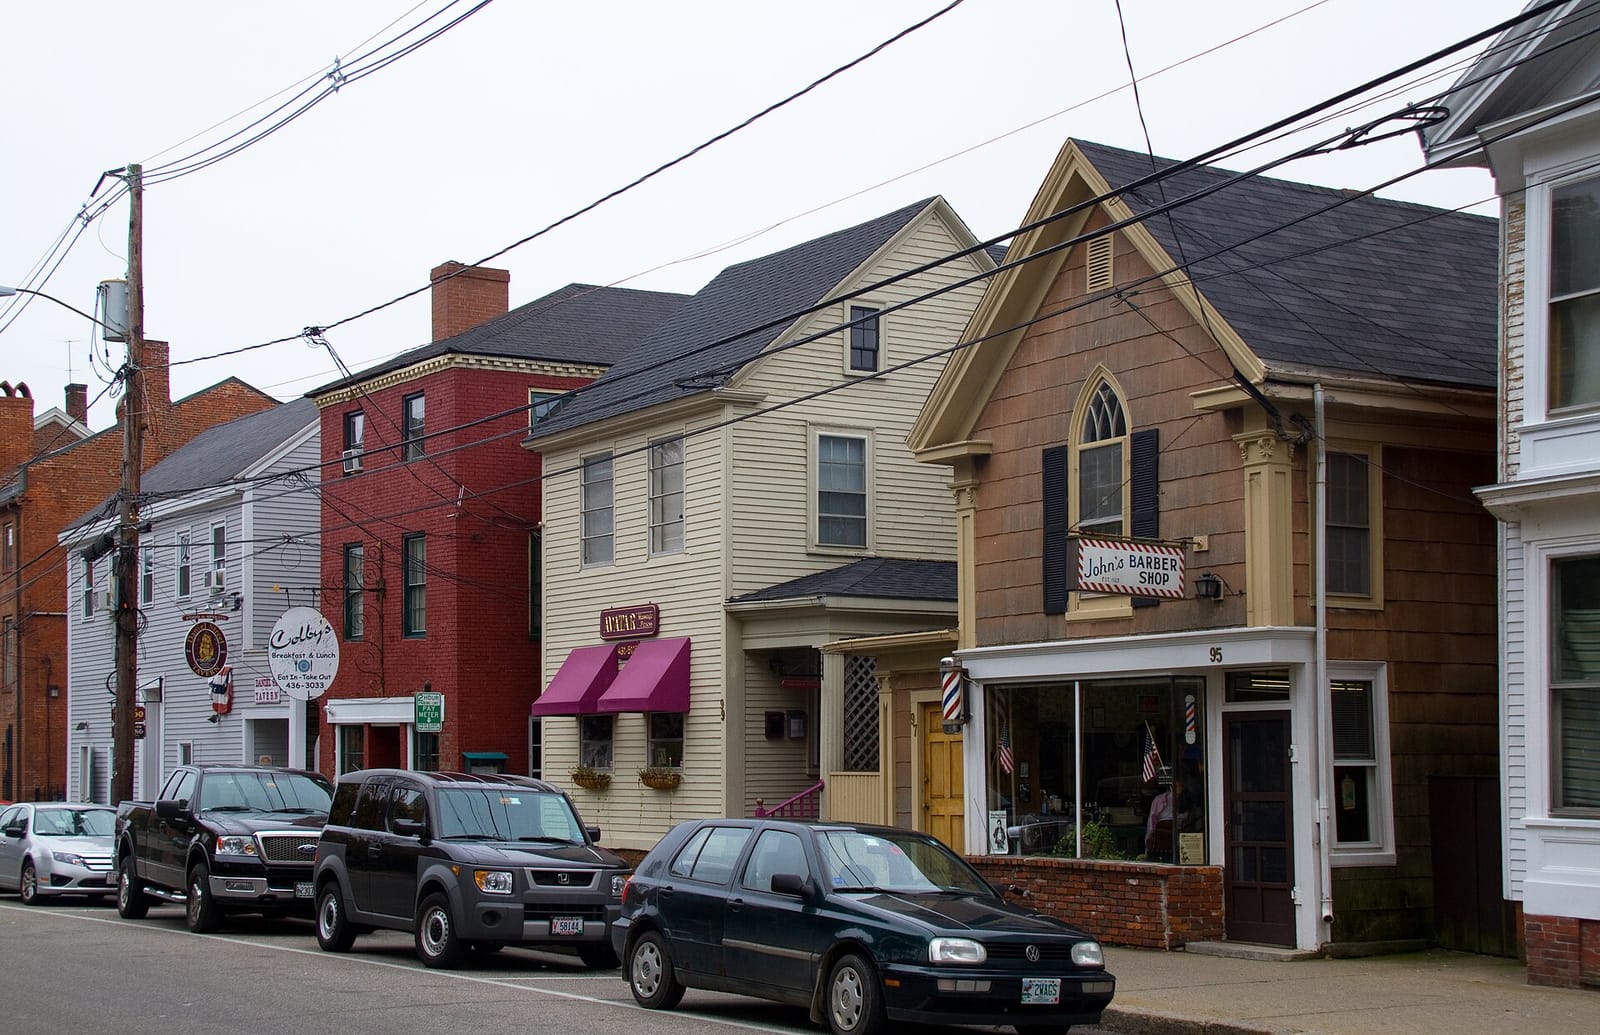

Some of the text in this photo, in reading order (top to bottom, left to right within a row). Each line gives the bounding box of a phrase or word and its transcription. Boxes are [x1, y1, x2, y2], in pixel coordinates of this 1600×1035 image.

[1084, 554, 1178, 578] John's BARBER
[1139, 571, 1170, 586] SHOP
[602, 612, 636, 633] AVATAR
[270, 619, 332, 649] Colby's
[271, 652, 306, 660] Breakfast
[1209, 646, 1223, 663] 95
[192, 665, 221, 677] TAVERN
[277, 673, 289, 681] Eat
[318, 673, 332, 681] Out
[255, 691, 279, 701] TAVERN
[417, 694, 424, 702] 2
[418, 711, 440, 719] METER
[1034, 983, 1058, 997] 2WAGS
